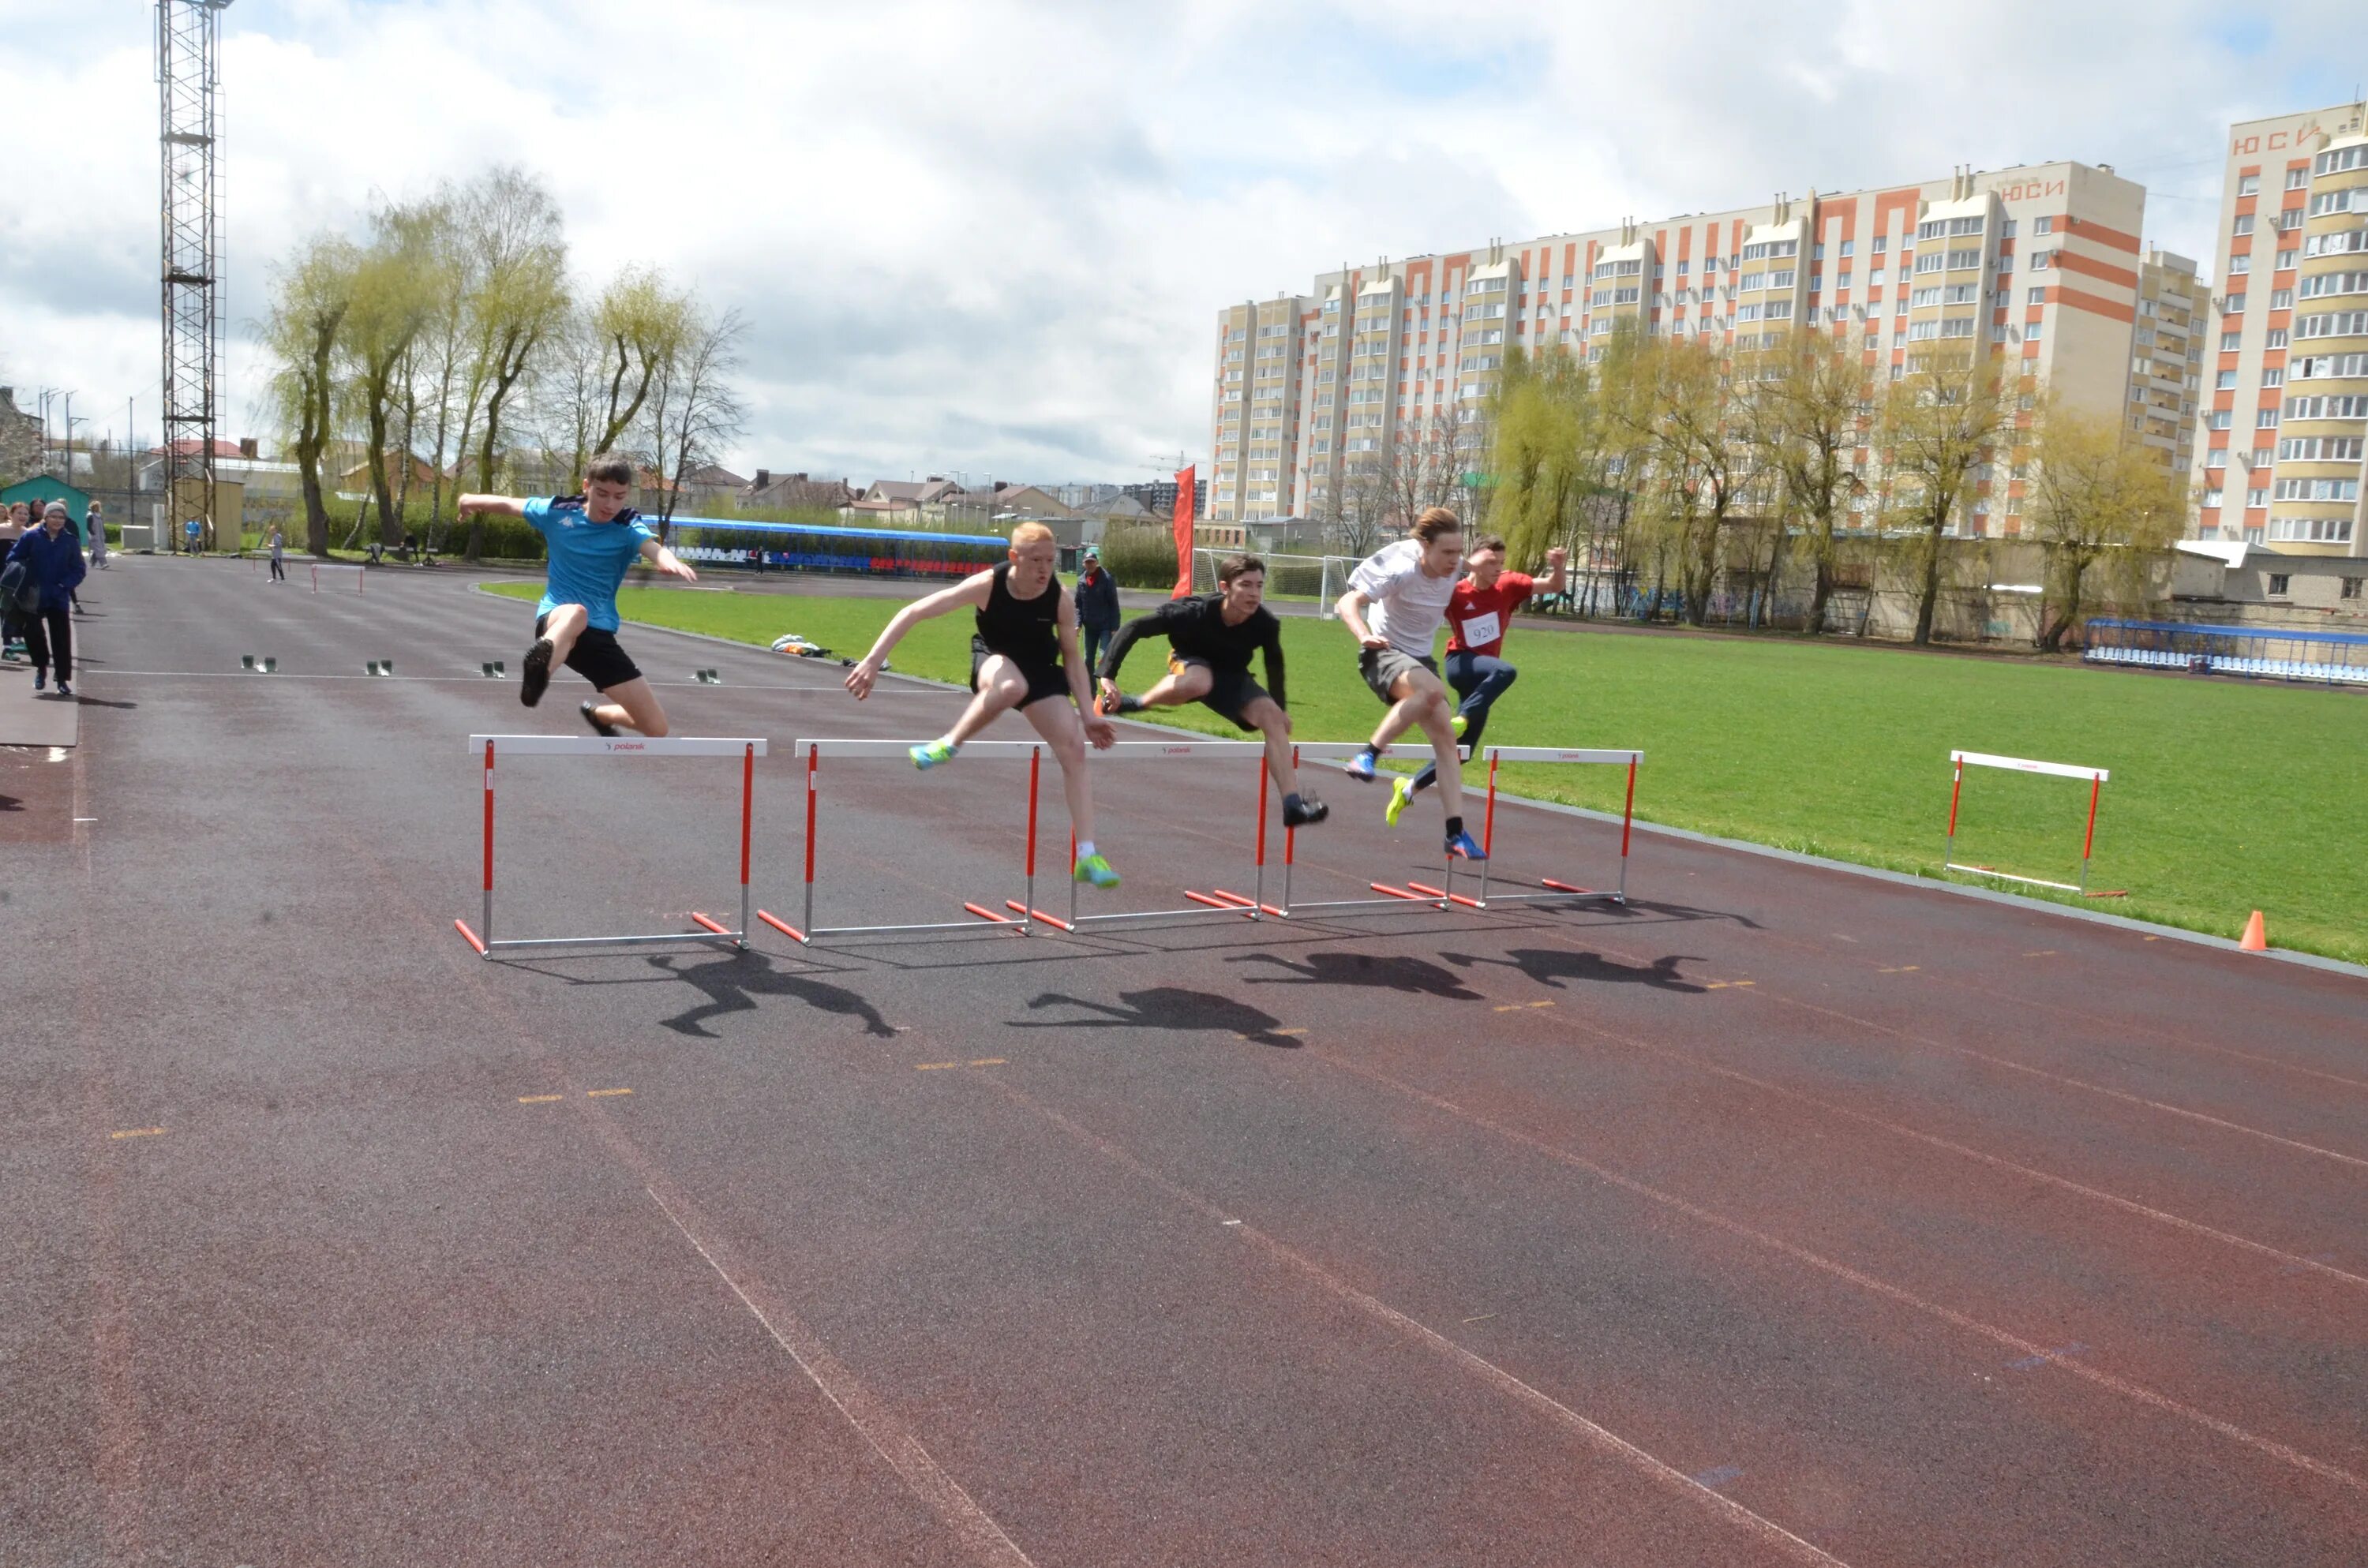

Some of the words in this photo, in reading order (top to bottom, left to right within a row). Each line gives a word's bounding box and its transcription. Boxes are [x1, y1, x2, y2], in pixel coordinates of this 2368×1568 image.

[2232, 126, 2321, 155] ЮСИ
[2002, 179, 2064, 202] ЮСИ
[1473, 624, 1494, 639] 920
[613, 743, 645, 751] polanik
